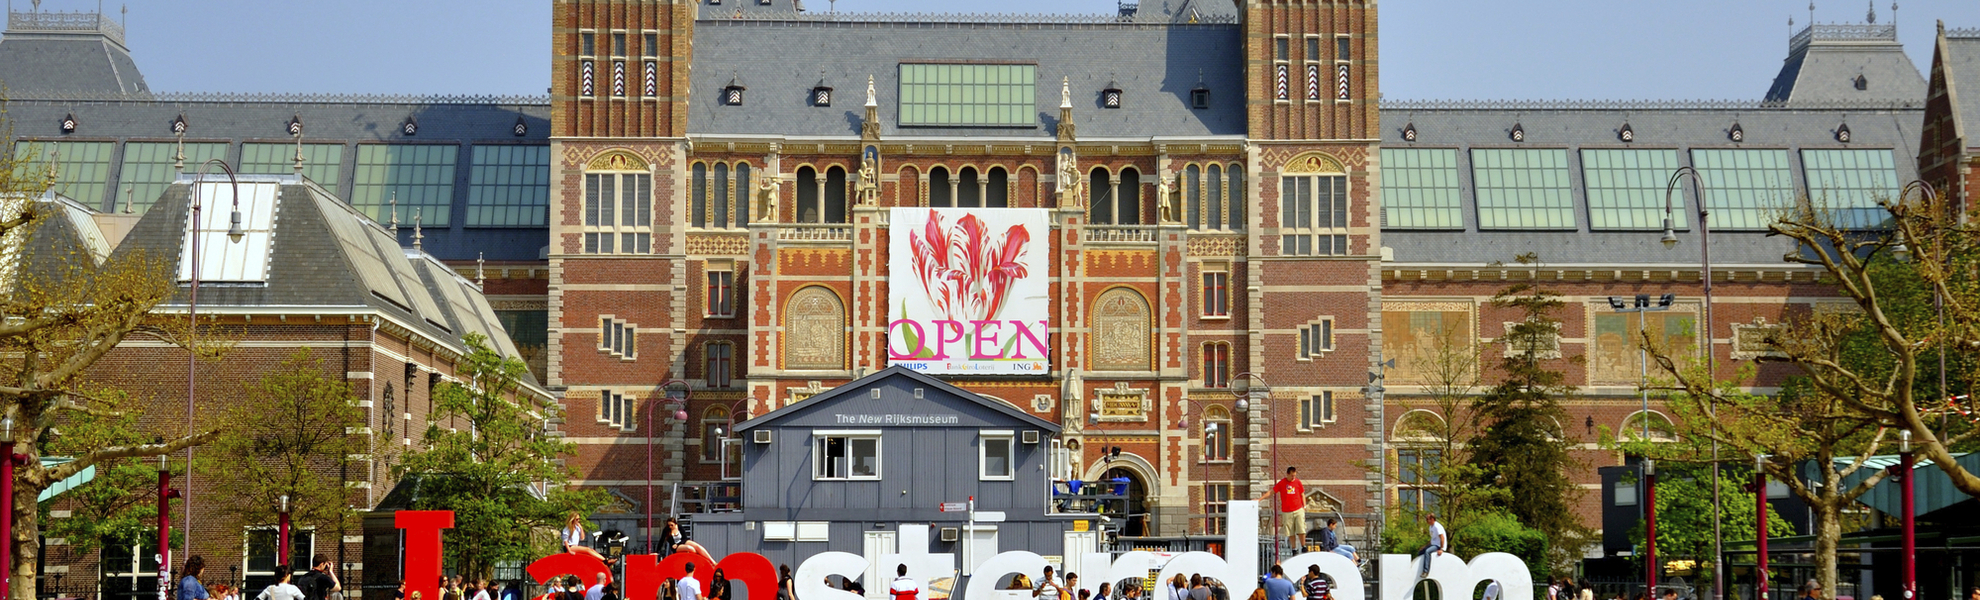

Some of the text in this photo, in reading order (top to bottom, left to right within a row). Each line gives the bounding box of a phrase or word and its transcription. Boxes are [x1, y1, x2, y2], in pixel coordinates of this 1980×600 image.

[890, 319, 1047, 359] OPEN
[895, 362, 928, 370] ILIPS
[1013, 363, 1031, 371] ING
[835, 413, 959, 426] The New Rijksmuseum
